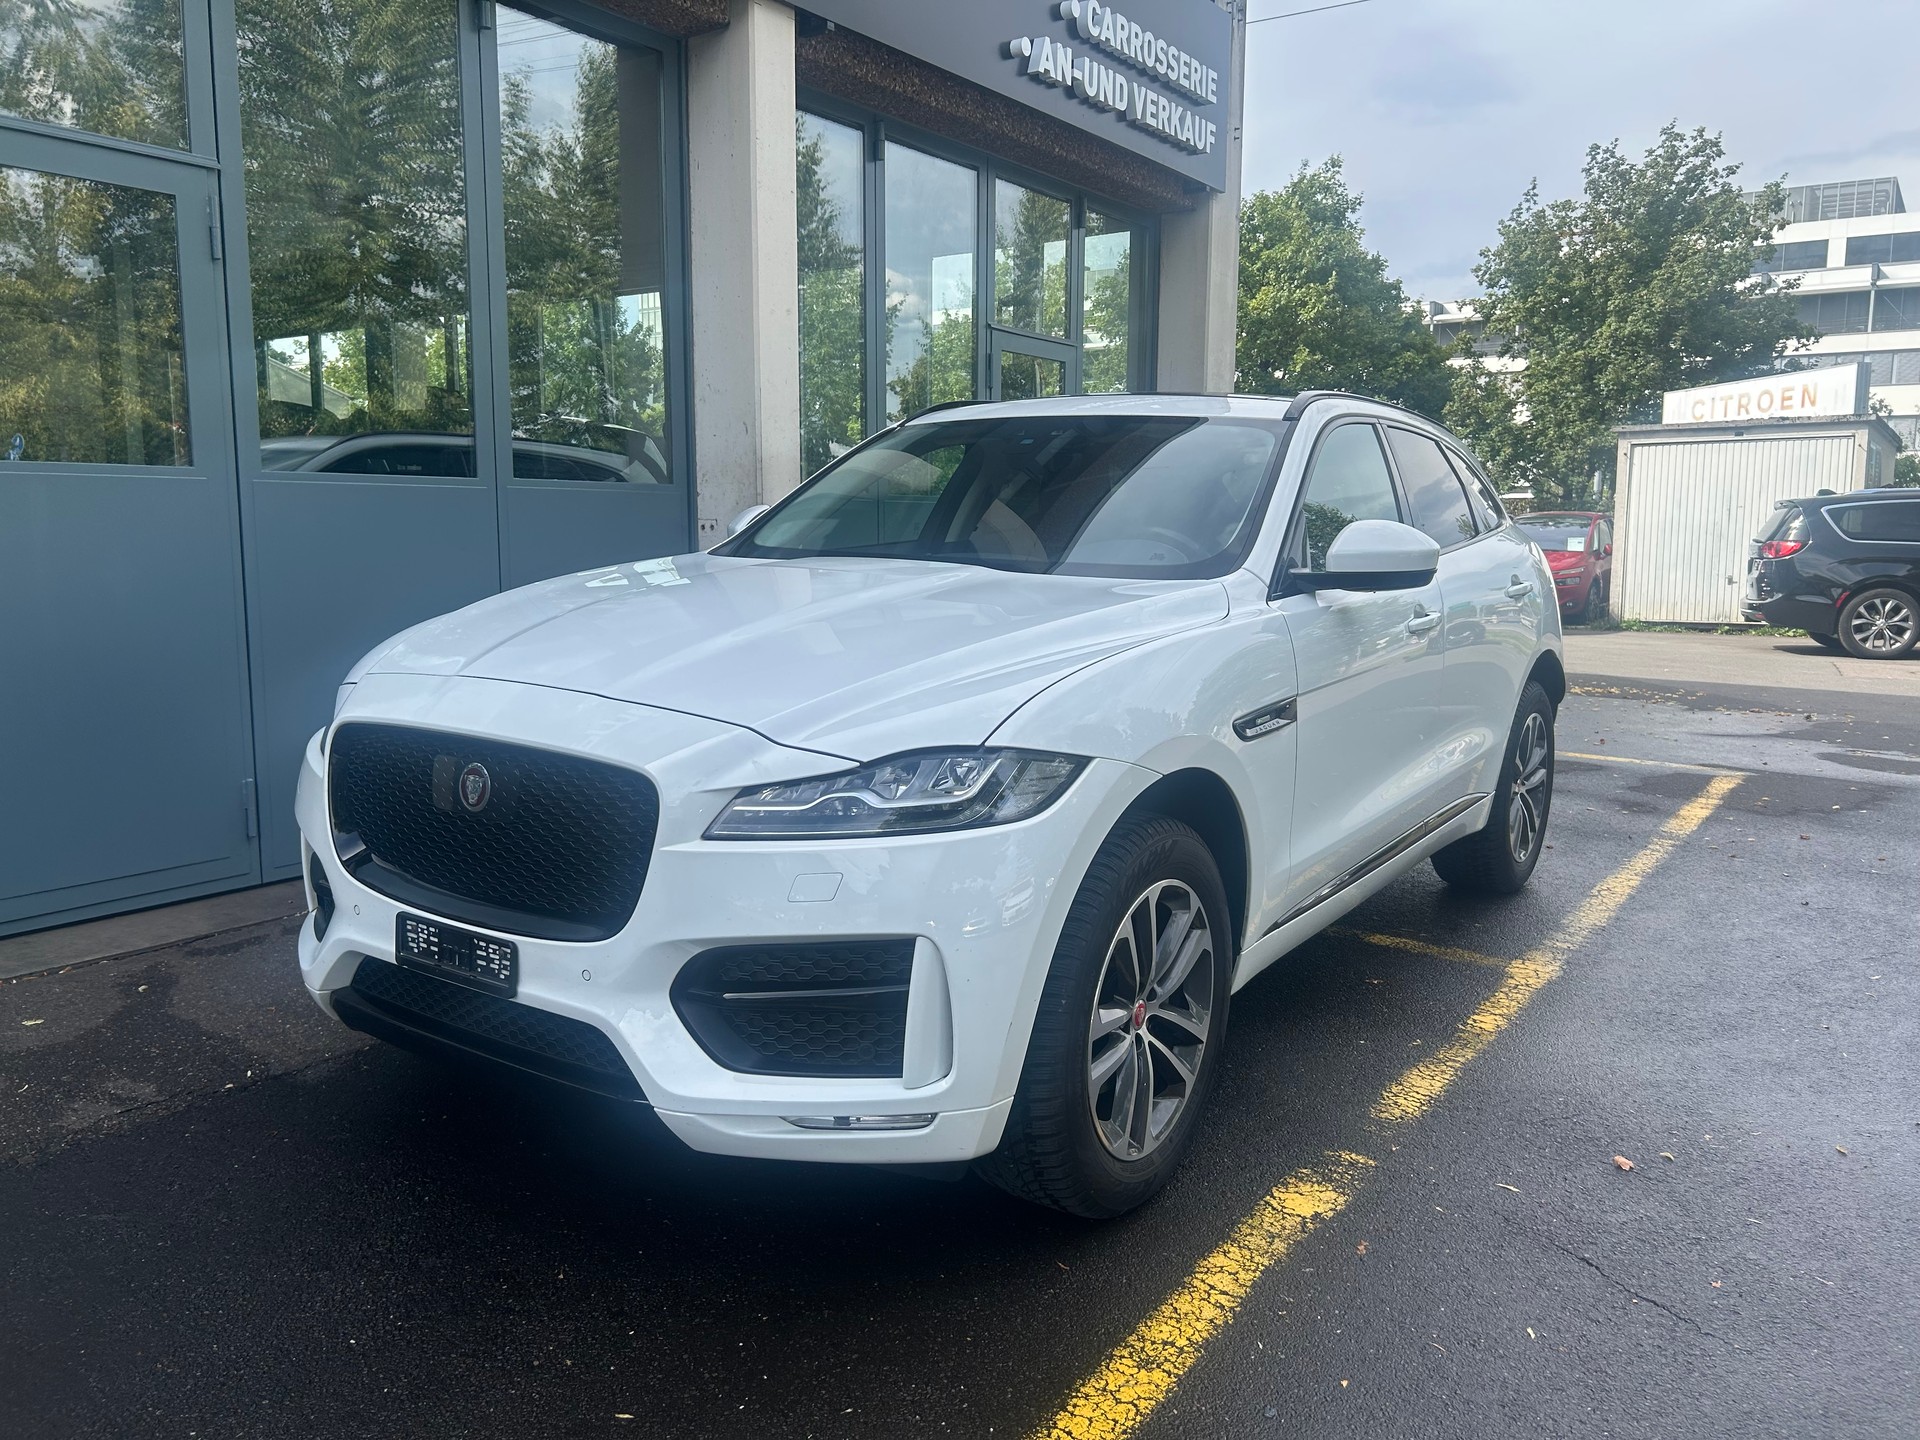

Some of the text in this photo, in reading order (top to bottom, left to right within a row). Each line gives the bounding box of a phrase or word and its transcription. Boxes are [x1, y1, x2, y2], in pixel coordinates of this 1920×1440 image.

[1080, 0, 1218, 104] CARROSSERIE
[1031, 36, 1217, 154] AN-UND VERKAUF
[1692, 383, 1818, 421] CITROEN
[1254, 719, 1281, 734] JAGUAR
